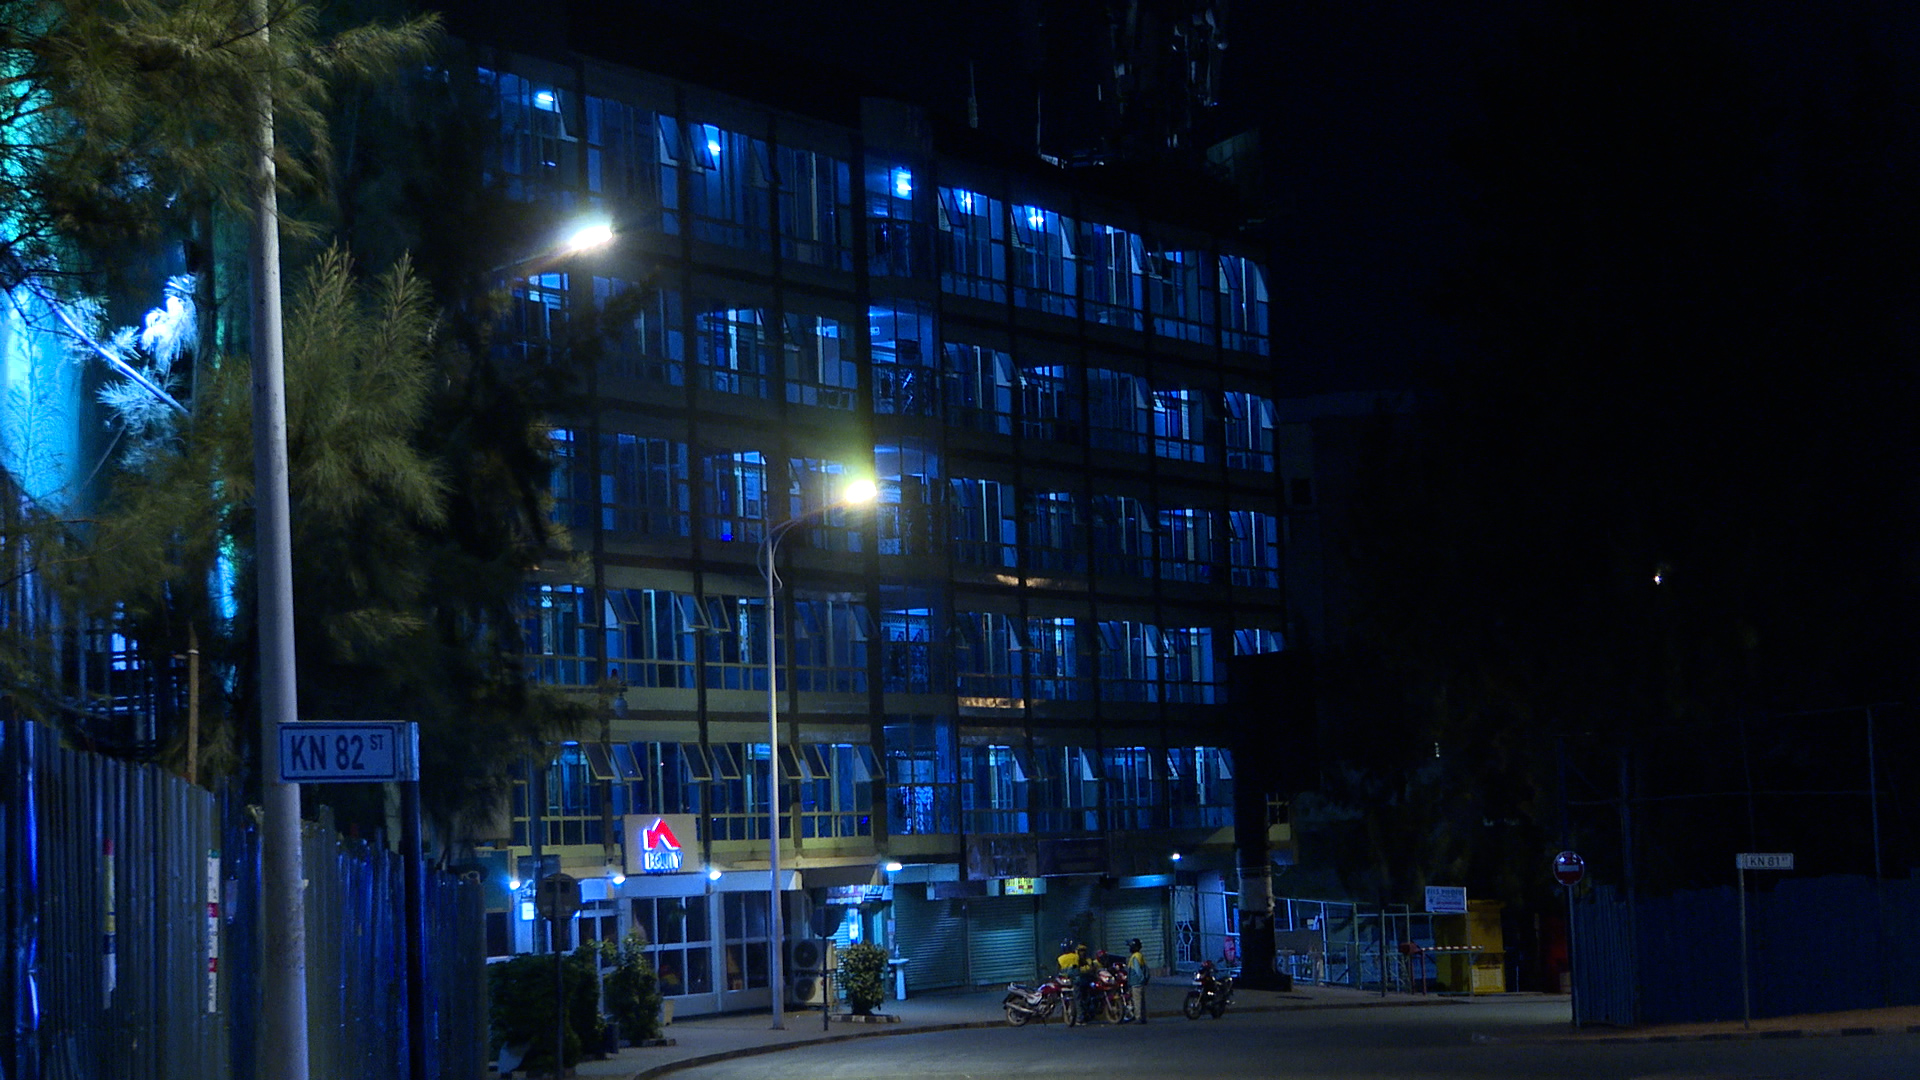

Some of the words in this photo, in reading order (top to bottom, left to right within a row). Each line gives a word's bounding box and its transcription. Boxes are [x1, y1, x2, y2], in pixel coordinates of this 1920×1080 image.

[291, 735, 326, 771] KN
[335, 734, 365, 770] 82
[370, 734, 384, 751] ST
[1750, 856, 1765, 866] KN
[1767, 856, 1780, 867] 81
